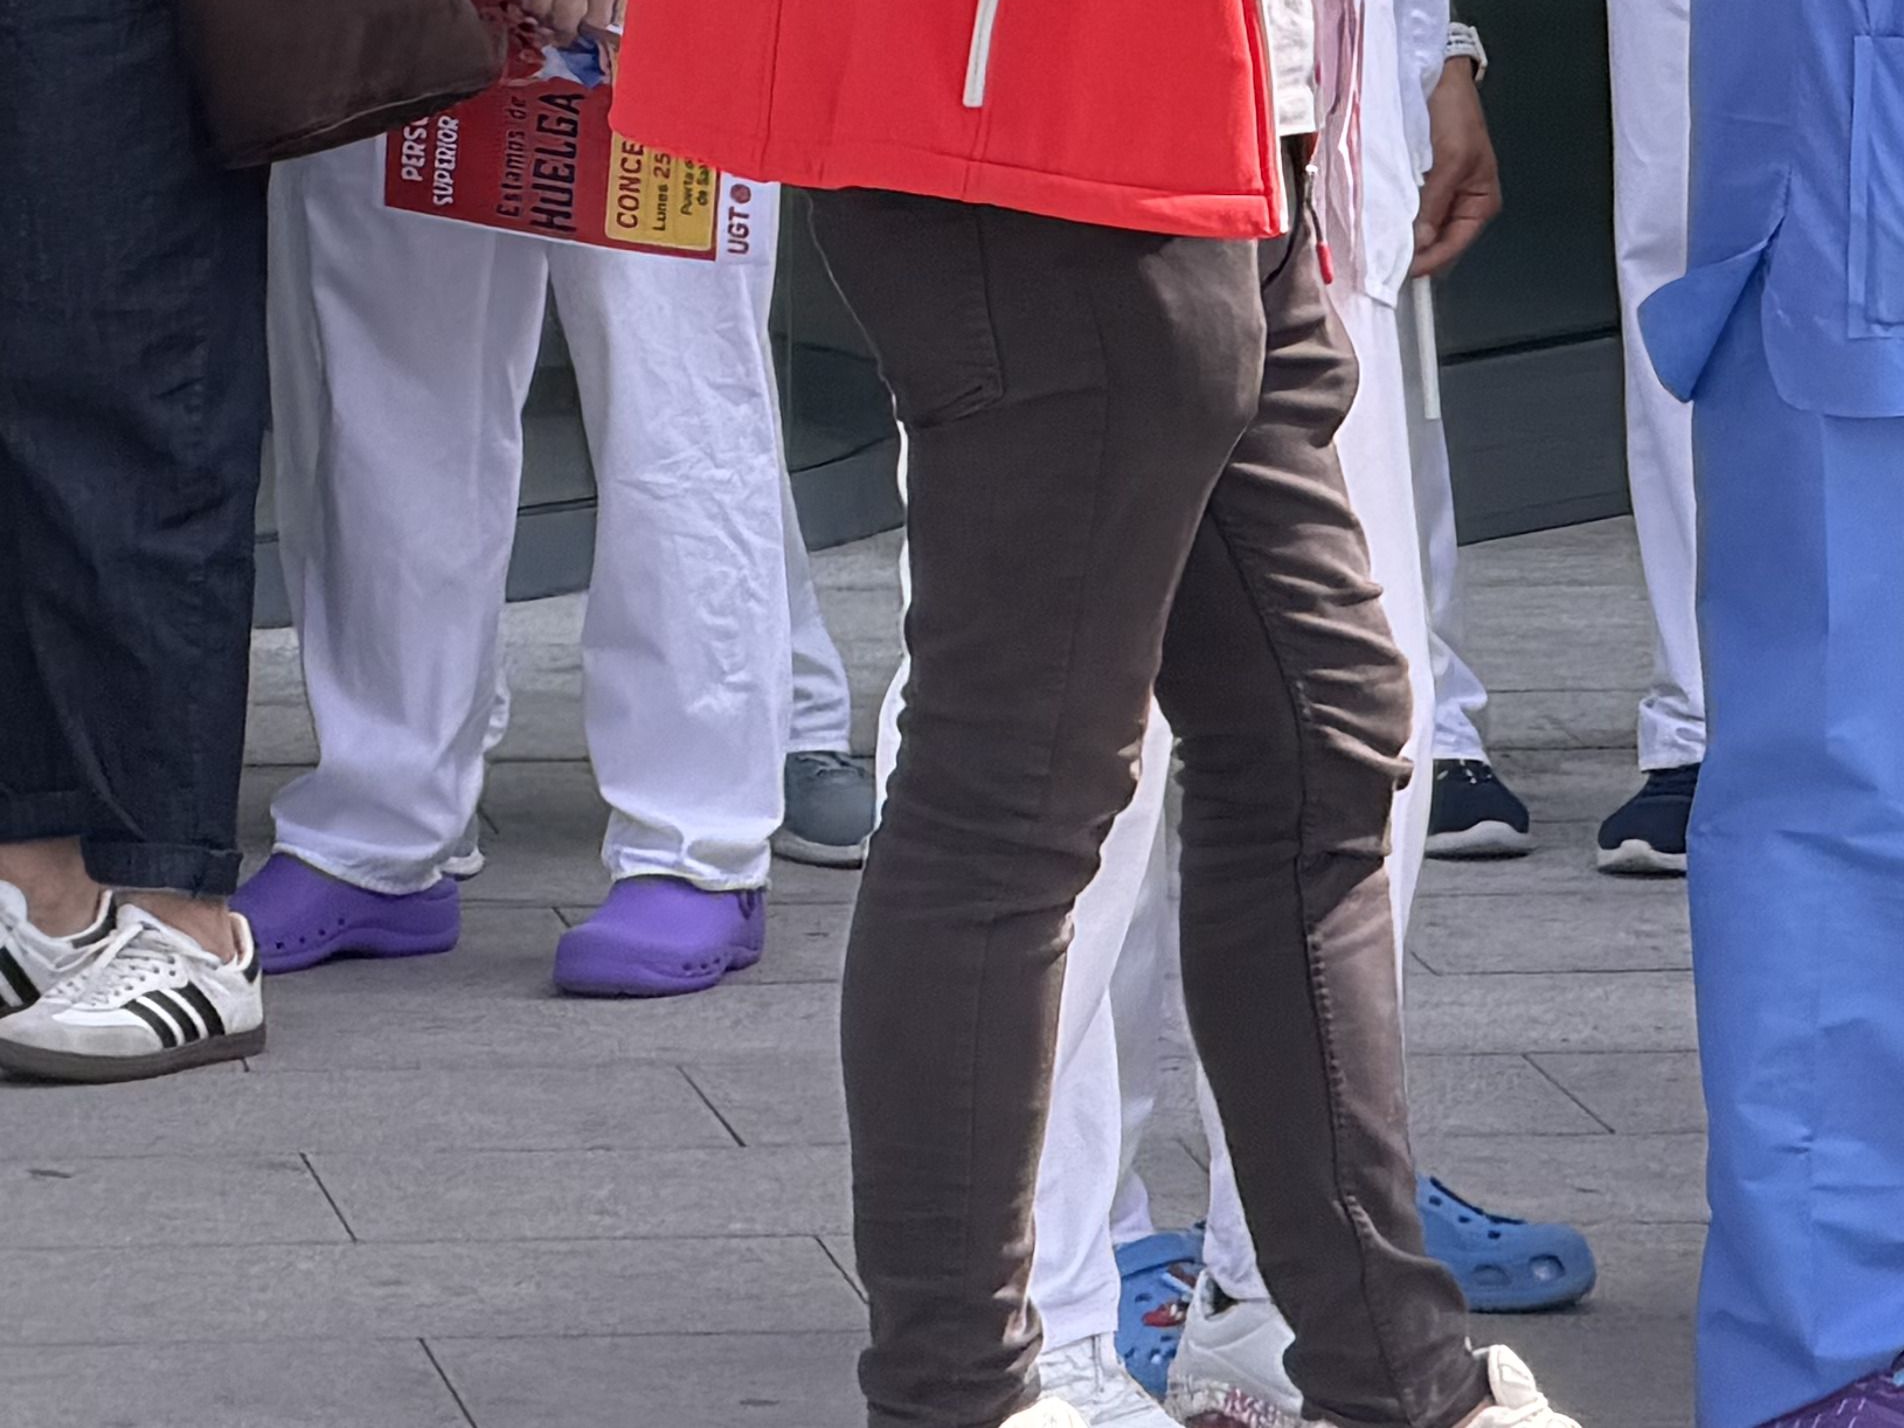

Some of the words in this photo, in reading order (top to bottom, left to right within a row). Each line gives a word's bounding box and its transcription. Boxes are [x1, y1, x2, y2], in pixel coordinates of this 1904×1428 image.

[433, 115, 460, 207] SUPERIOR
[497, 128, 526, 219] Estamos
[529, 92, 585, 234] HUELGA
[727, 208, 752, 256] UGT
